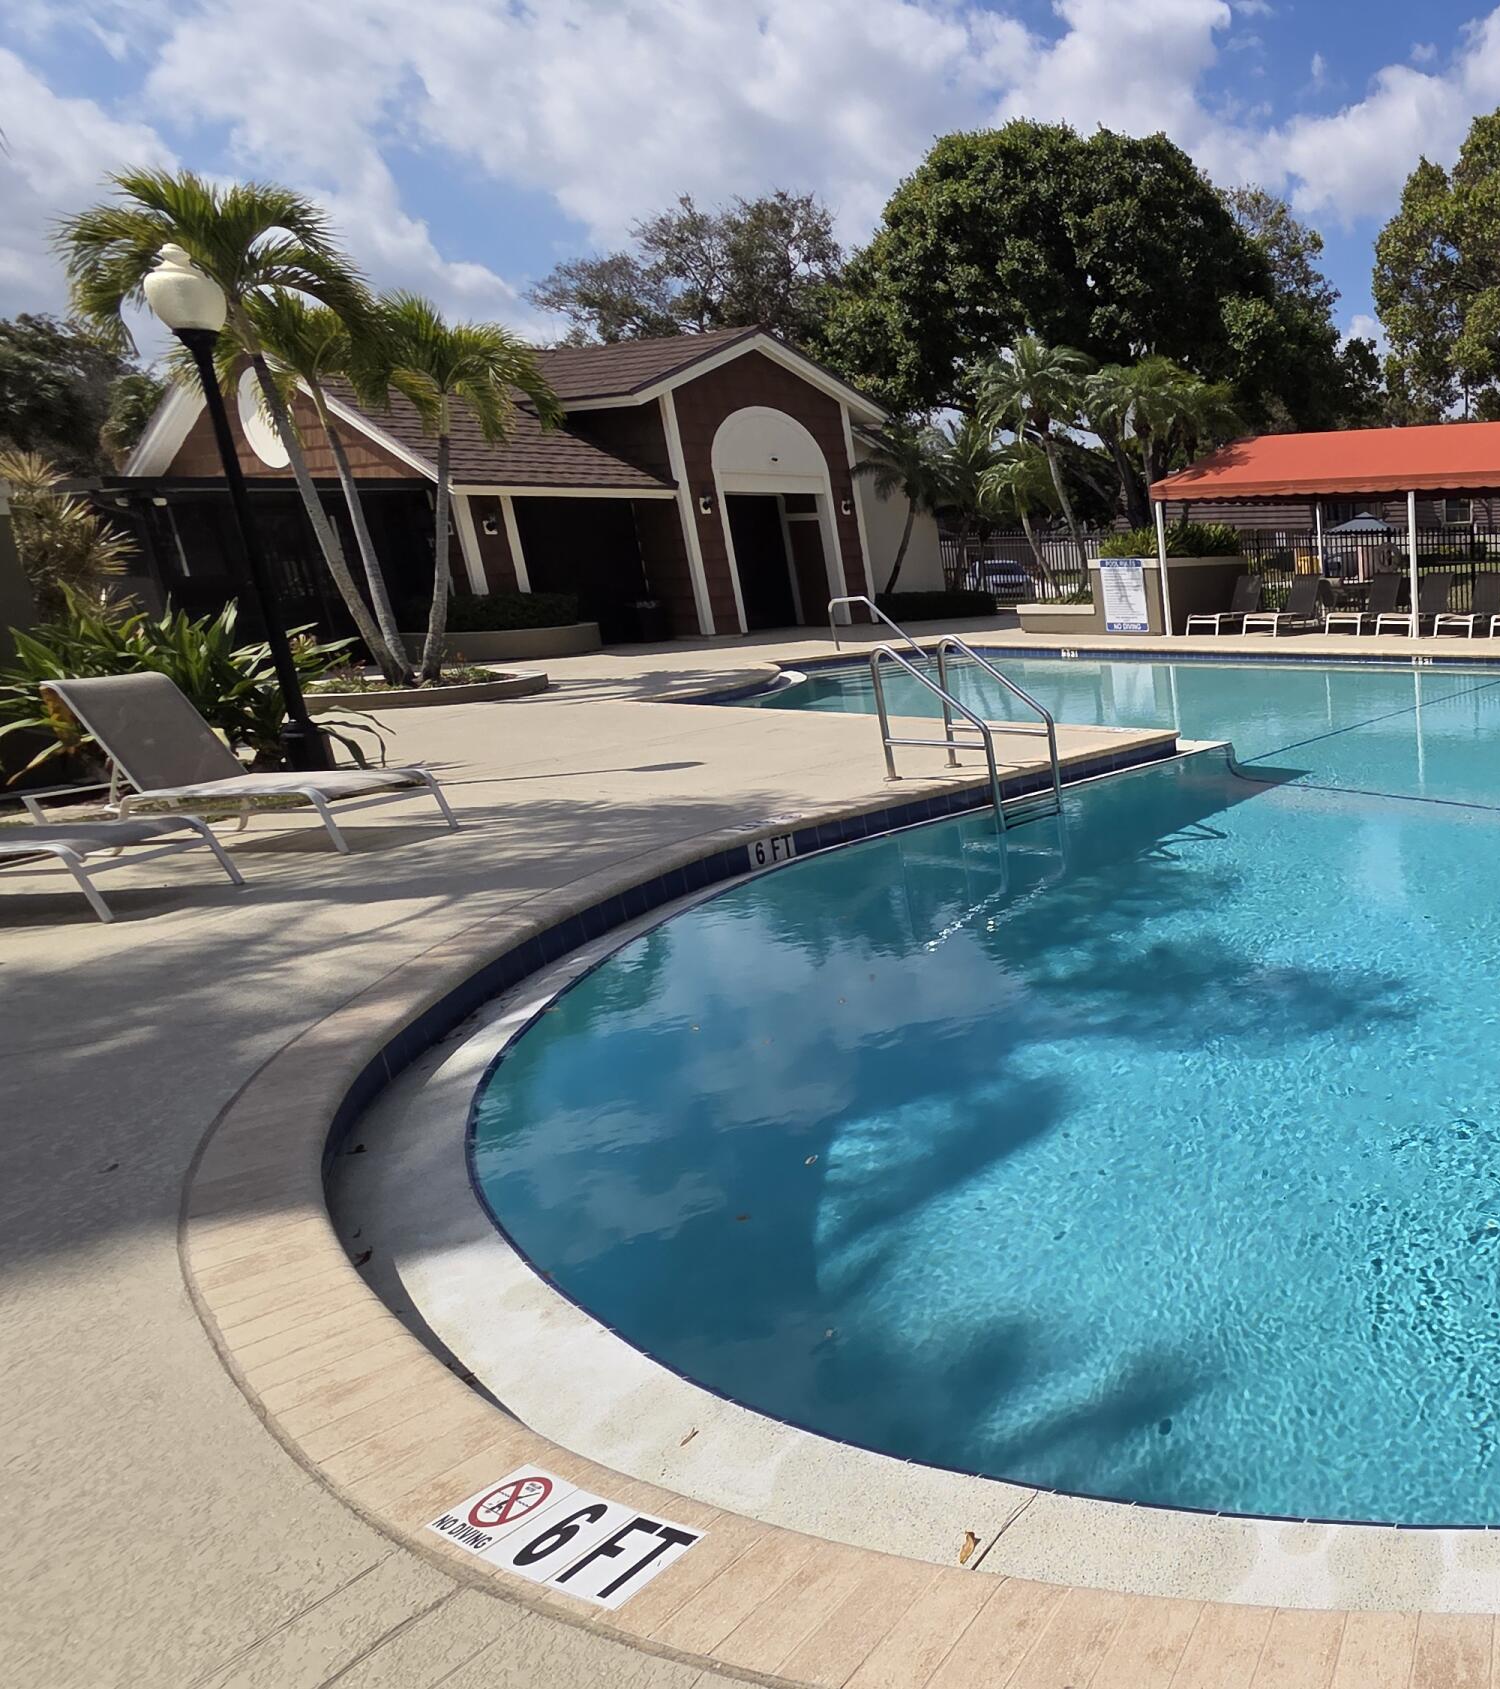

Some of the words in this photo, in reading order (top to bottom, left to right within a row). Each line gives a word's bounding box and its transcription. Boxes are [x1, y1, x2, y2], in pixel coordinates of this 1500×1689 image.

[755, 842, 766, 865] 6
[771, 834, 791, 861] FT
[431, 1514, 460, 1531] NO
[447, 1522, 493, 1549] DIVING
[512, 1503, 608, 1566] 6
[555, 1517, 699, 1599] FT
